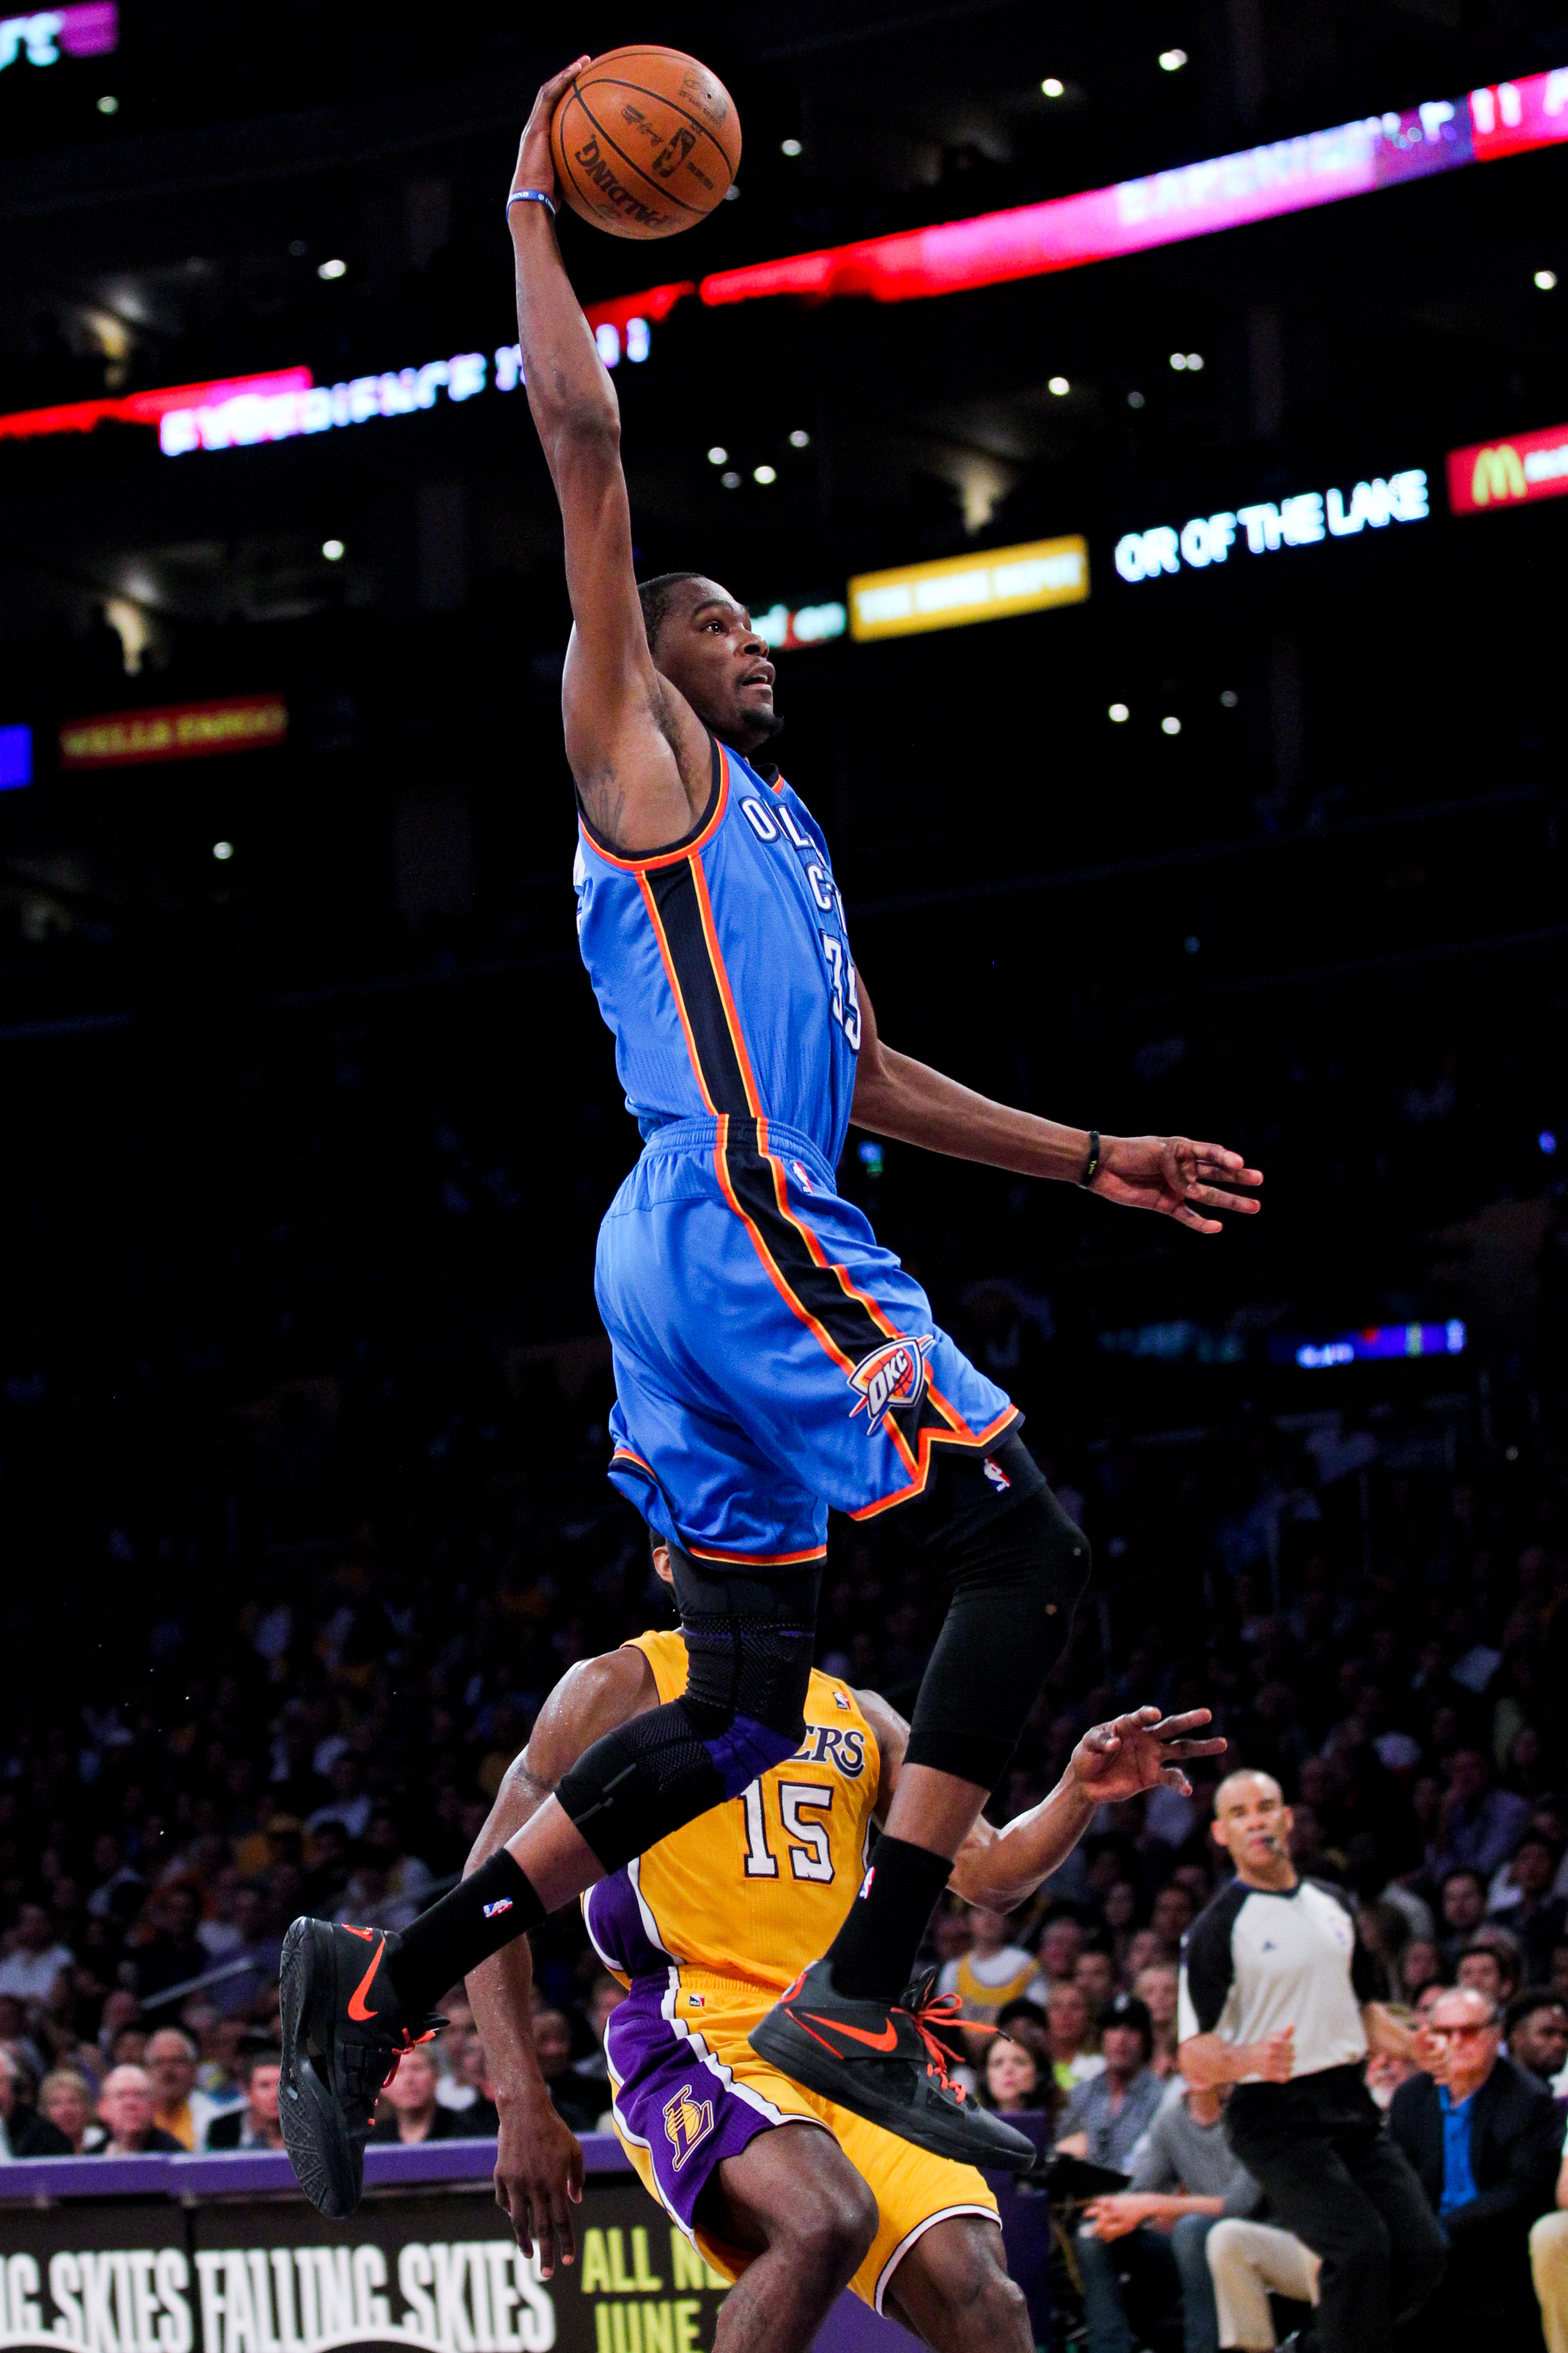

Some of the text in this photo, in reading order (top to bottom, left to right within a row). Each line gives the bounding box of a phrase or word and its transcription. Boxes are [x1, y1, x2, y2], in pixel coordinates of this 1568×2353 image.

[1180, 518, 1237, 568] OF
[1237, 492, 1325, 553] THE
[820, 928, 862, 1055] 35
[869, 1349, 908, 1417] OKC
[737, 1776, 836, 1885] 15
[48, 2247, 195, 2353] SKIES
[194, 2238, 557, 2353] FALLING SKIES
[581, 2226, 663, 2294] ALL
[594, 2298, 705, 2353] JUNE
